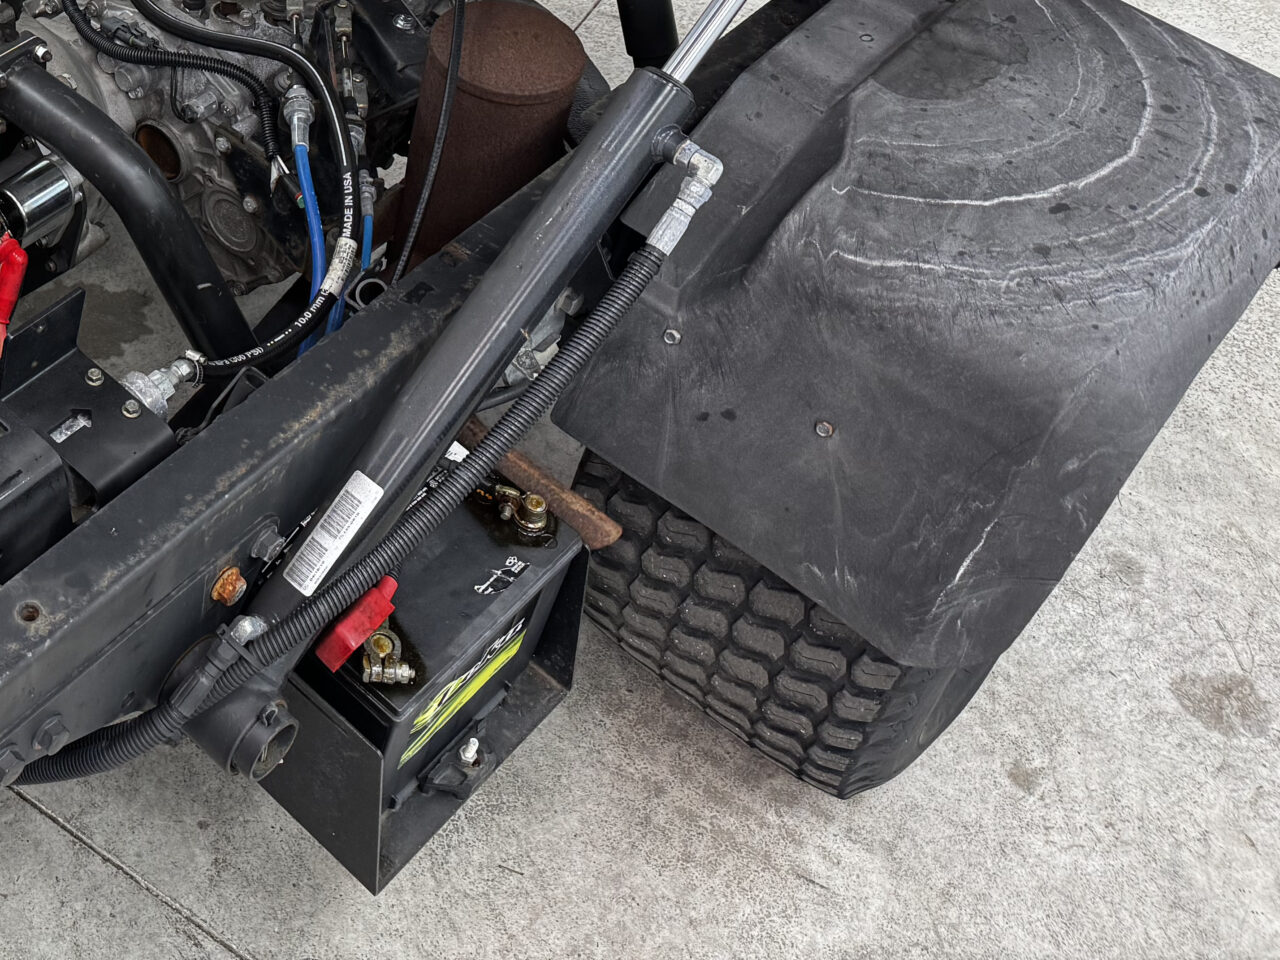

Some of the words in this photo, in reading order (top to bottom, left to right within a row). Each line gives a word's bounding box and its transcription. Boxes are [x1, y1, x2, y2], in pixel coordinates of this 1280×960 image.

[343, 171, 353, 194] USA
[344, 195, 353, 206] IN
[342, 207, 353, 238] MADE
[310, 296, 326, 312] mm
